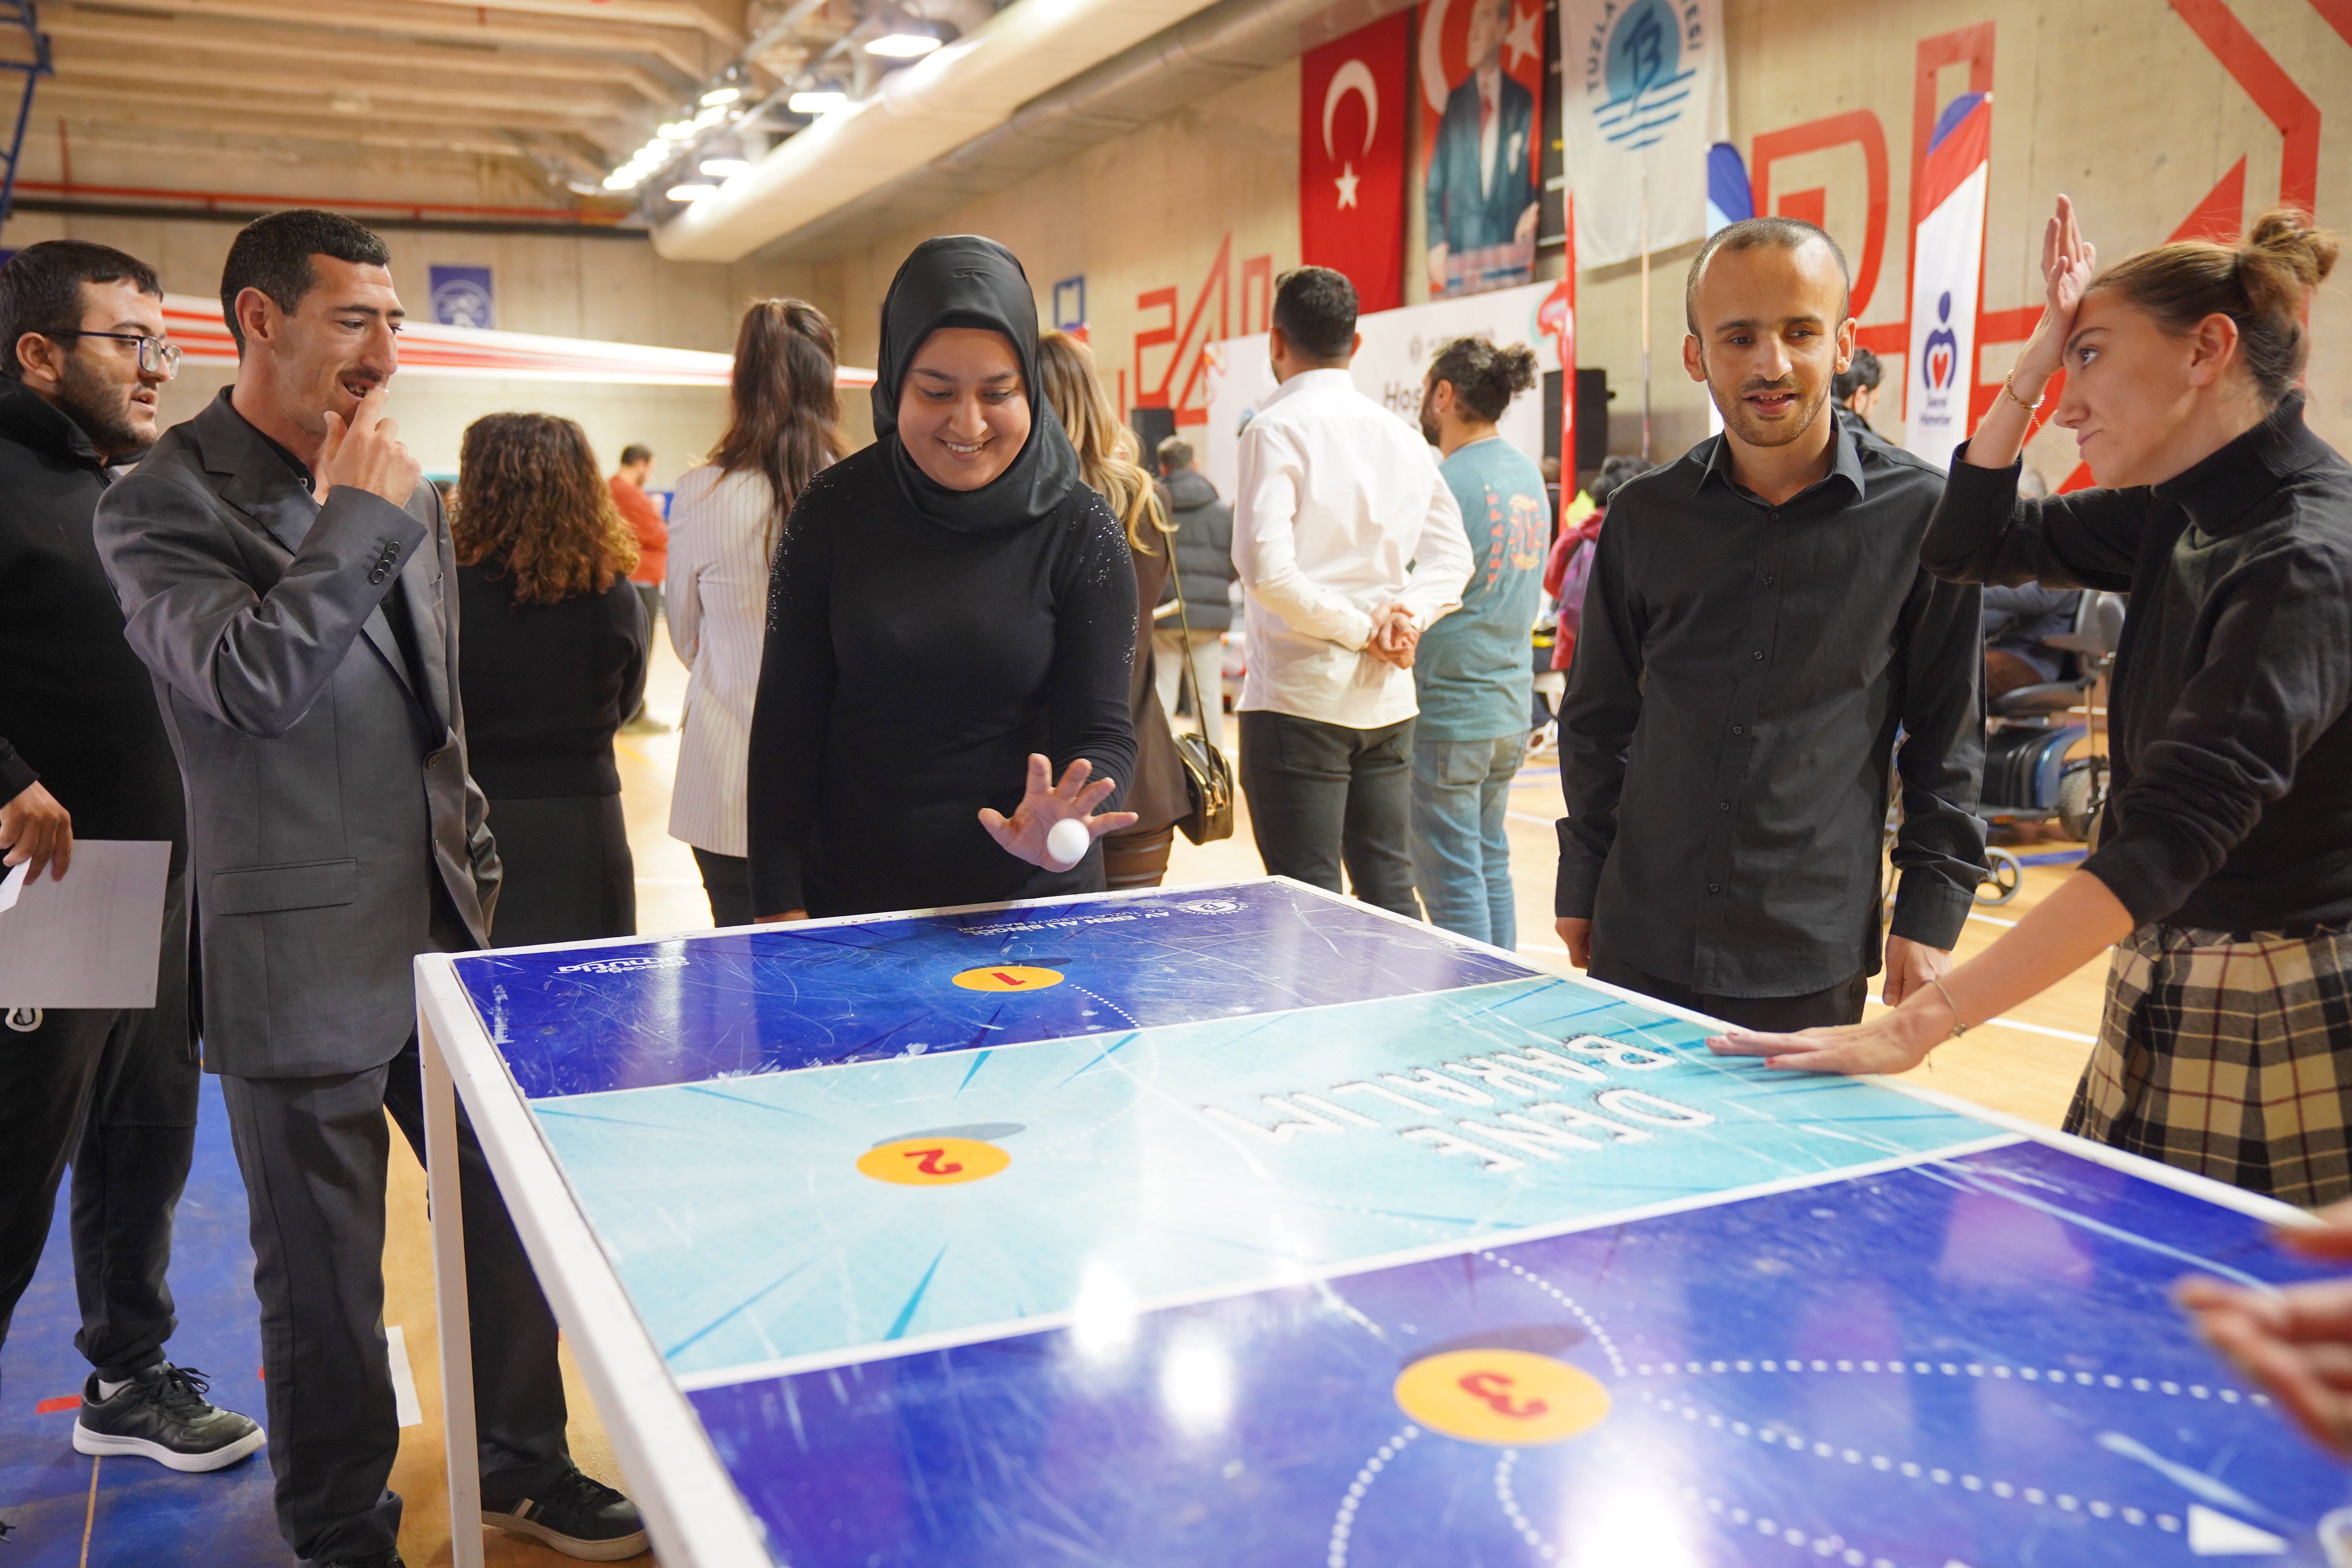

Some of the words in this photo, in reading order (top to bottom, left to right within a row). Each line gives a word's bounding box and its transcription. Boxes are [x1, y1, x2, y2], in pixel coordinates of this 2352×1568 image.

[1586, 1, 1616, 95] TUZLA
[1486, 493, 1504, 583] ESCAPE
[958, 922, 1025, 931] BAŞKANI
[1045, 920, 1078, 929] ALİ
[1084, 915, 1138, 924] EREN
[963, 924, 1045, 936] BİNGÖL
[557, 955, 688, 973] umutla
[595, 960, 690, 974] geleceğe
[991, 972, 1027, 986] 1
[1201, 1033, 1679, 1145] BAKALIM
[1398, 1087, 1716, 1173] DENE
[904, 1148, 963, 1175] 2
[1458, 1372, 1550, 1417] 3
